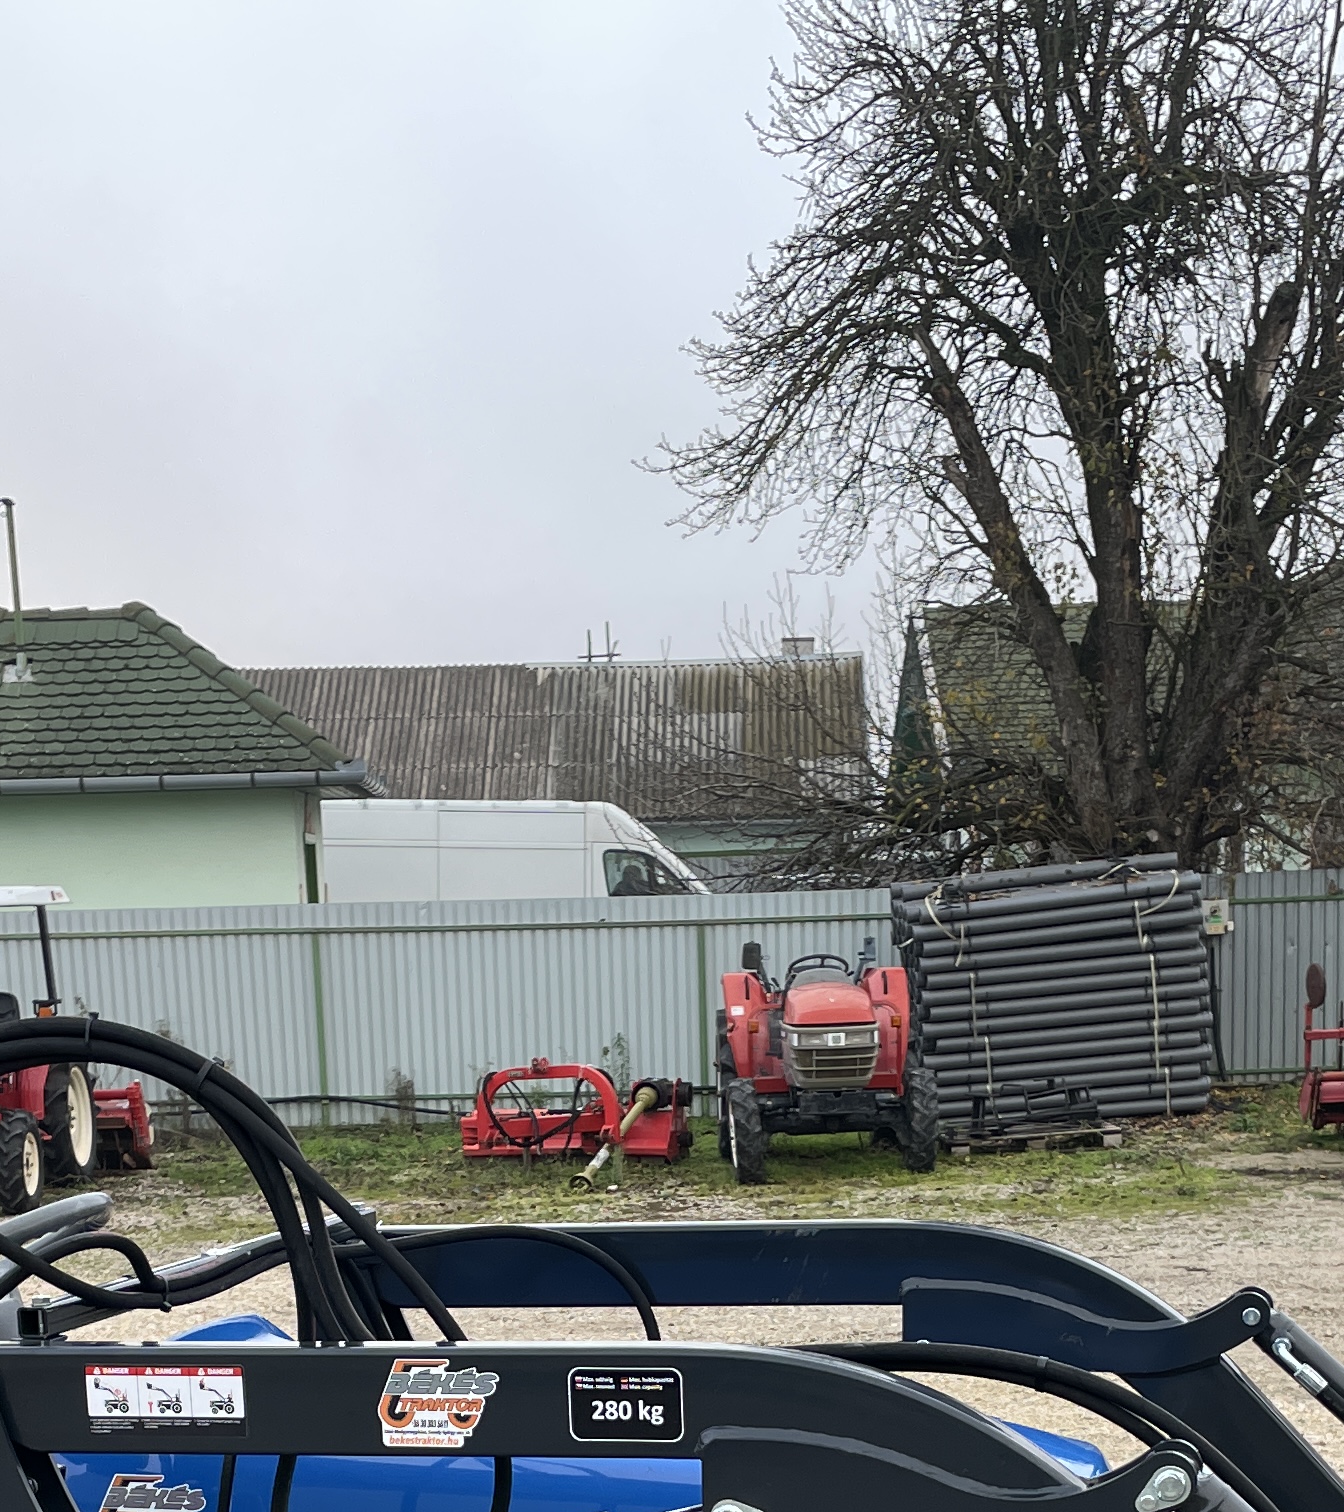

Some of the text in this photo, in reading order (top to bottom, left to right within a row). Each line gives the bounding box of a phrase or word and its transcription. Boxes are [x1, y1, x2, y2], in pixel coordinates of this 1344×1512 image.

[385, 1369, 498, 1395] BÉKÉS
[399, 1397, 484, 1412] TRAKTOR
[592, 1400, 664, 1425] 280 kg
[389, 1435, 459, 1445] bekestraktor.hu
[103, 1484, 204, 1510] BÉKÉS
